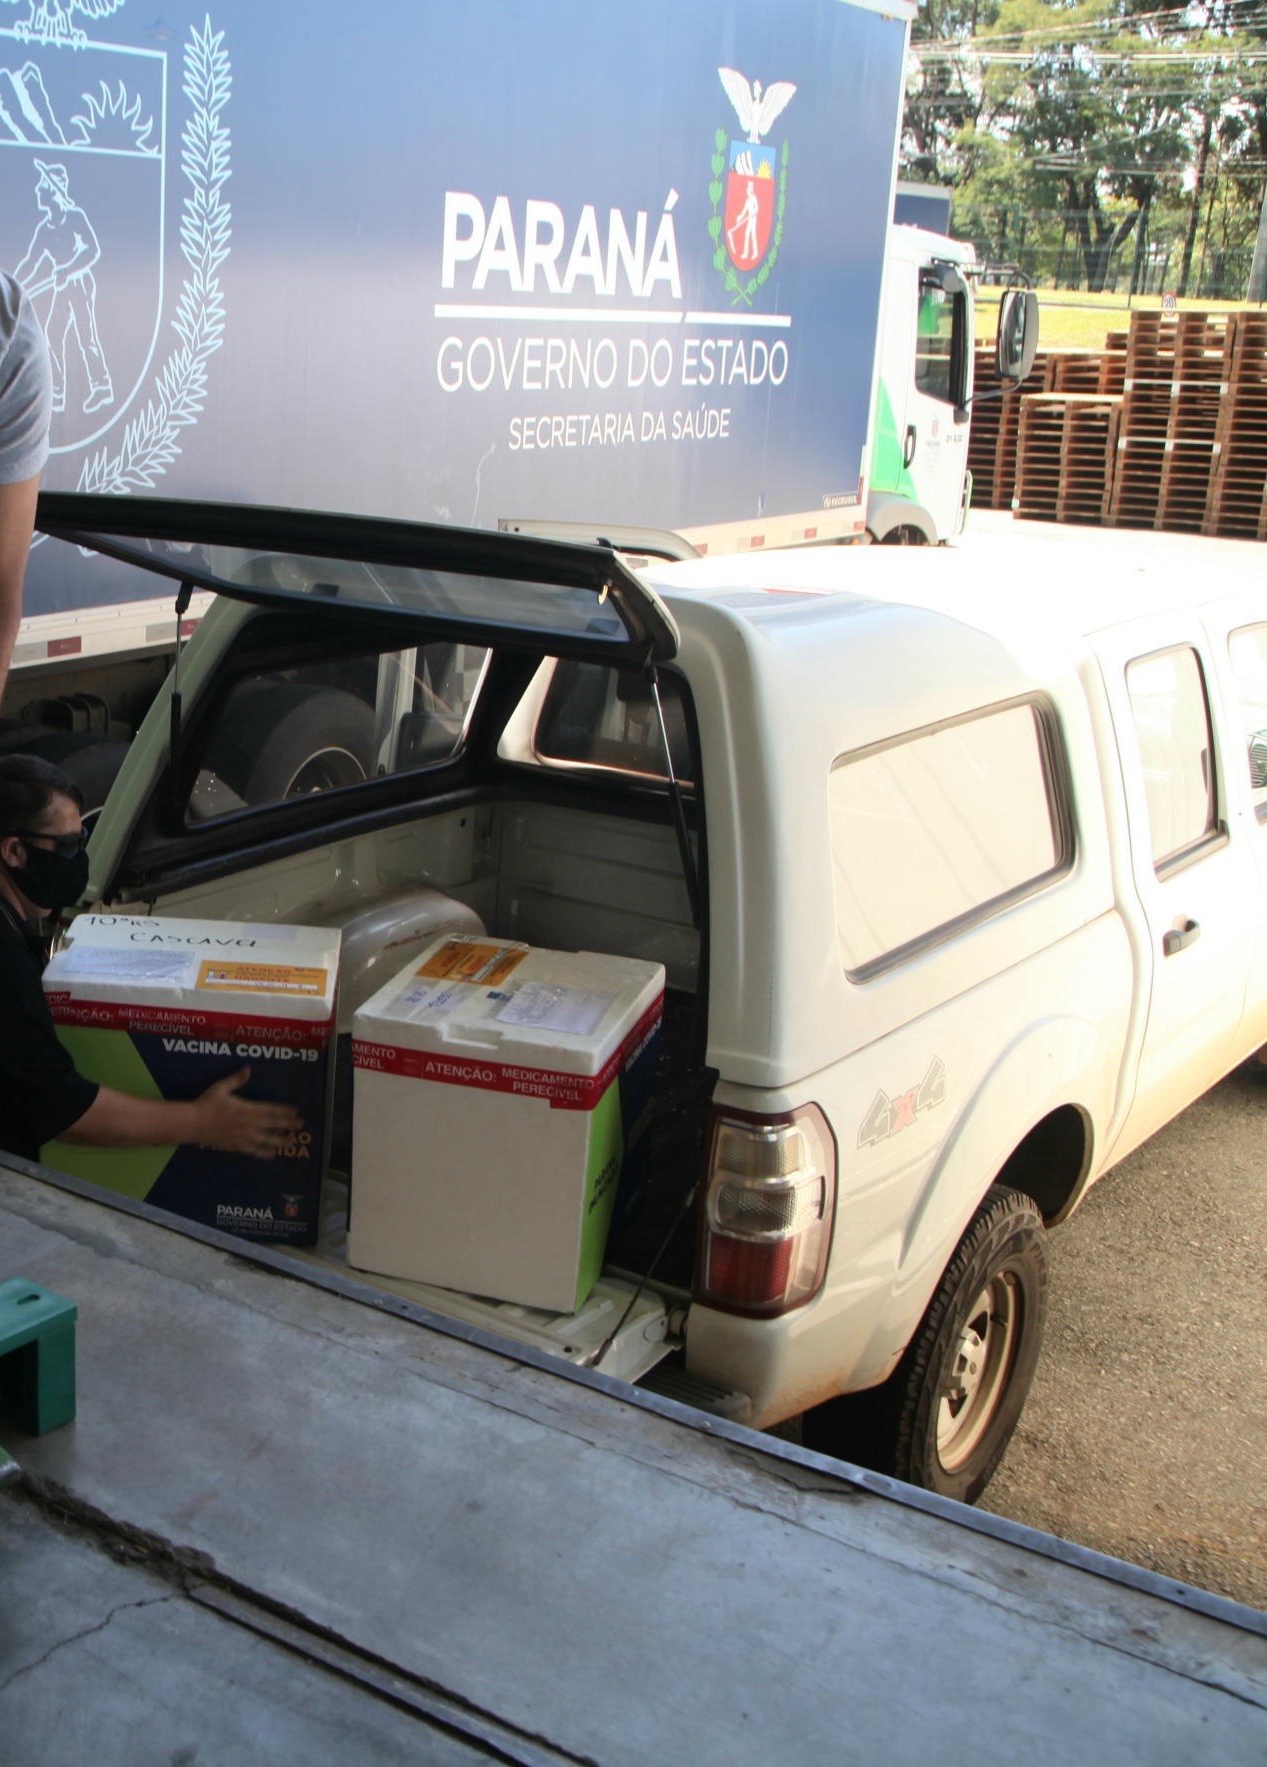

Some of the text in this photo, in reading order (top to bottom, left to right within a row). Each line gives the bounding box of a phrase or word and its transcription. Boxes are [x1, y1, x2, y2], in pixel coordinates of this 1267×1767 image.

[441, 188, 682, 299] PARANÁ
[436, 336, 789, 393] GOVERNO DO ESTADO
[508, 403, 732, 451] SECRETARIA DA SAÚDE
[118, 1008, 206, 1026] MEDICAMENTO
[235, 1025, 307, 1042] ATENÇÃO:
[129, 1020, 194, 1036] PERECÍVEL
[162, 1038, 319, 1062] VACINA COVID-19
[425, 1061, 497, 1083] ATENÇÃO:
[501, 1067, 595, 1090] MEDICAMENTO
[513, 1081, 582, 1101] PERECÍVEL
[216, 1204, 274, 1220] PARANÁ
[216, 1219, 308, 1233] GOVERNO DO ESTADO
